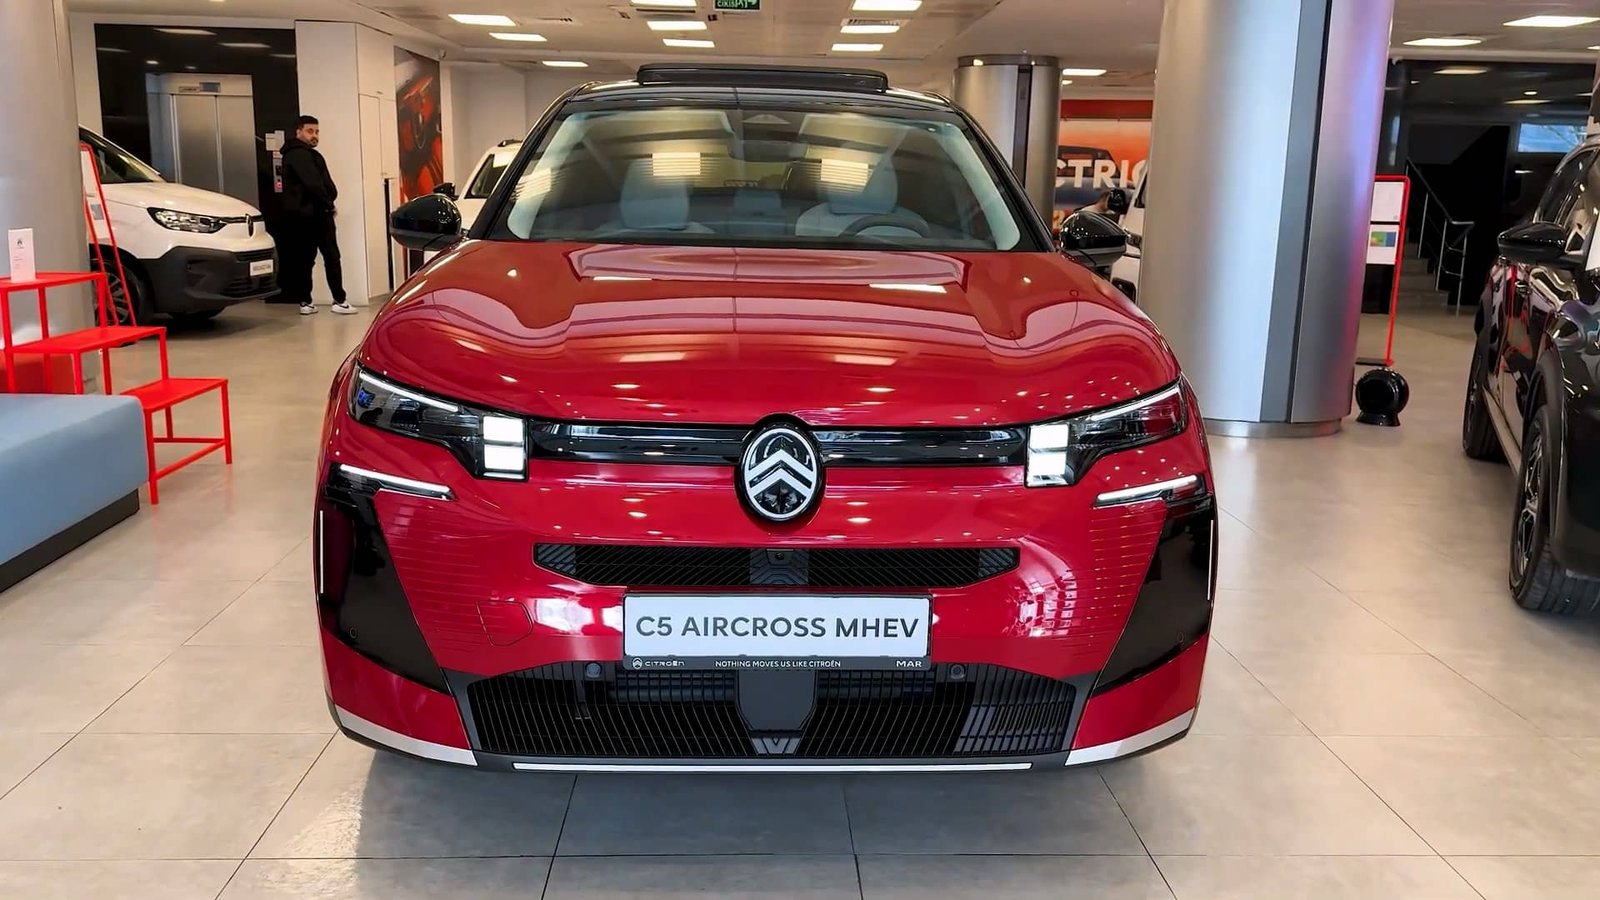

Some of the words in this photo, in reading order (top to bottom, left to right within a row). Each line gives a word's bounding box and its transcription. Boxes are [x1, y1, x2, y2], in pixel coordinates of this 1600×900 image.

[636, 616, 673, 637] C5
[681, 616, 826, 637] AIRCROSS
[835, 618, 919, 638] MHEV
[896, 660, 922, 668] MAR
